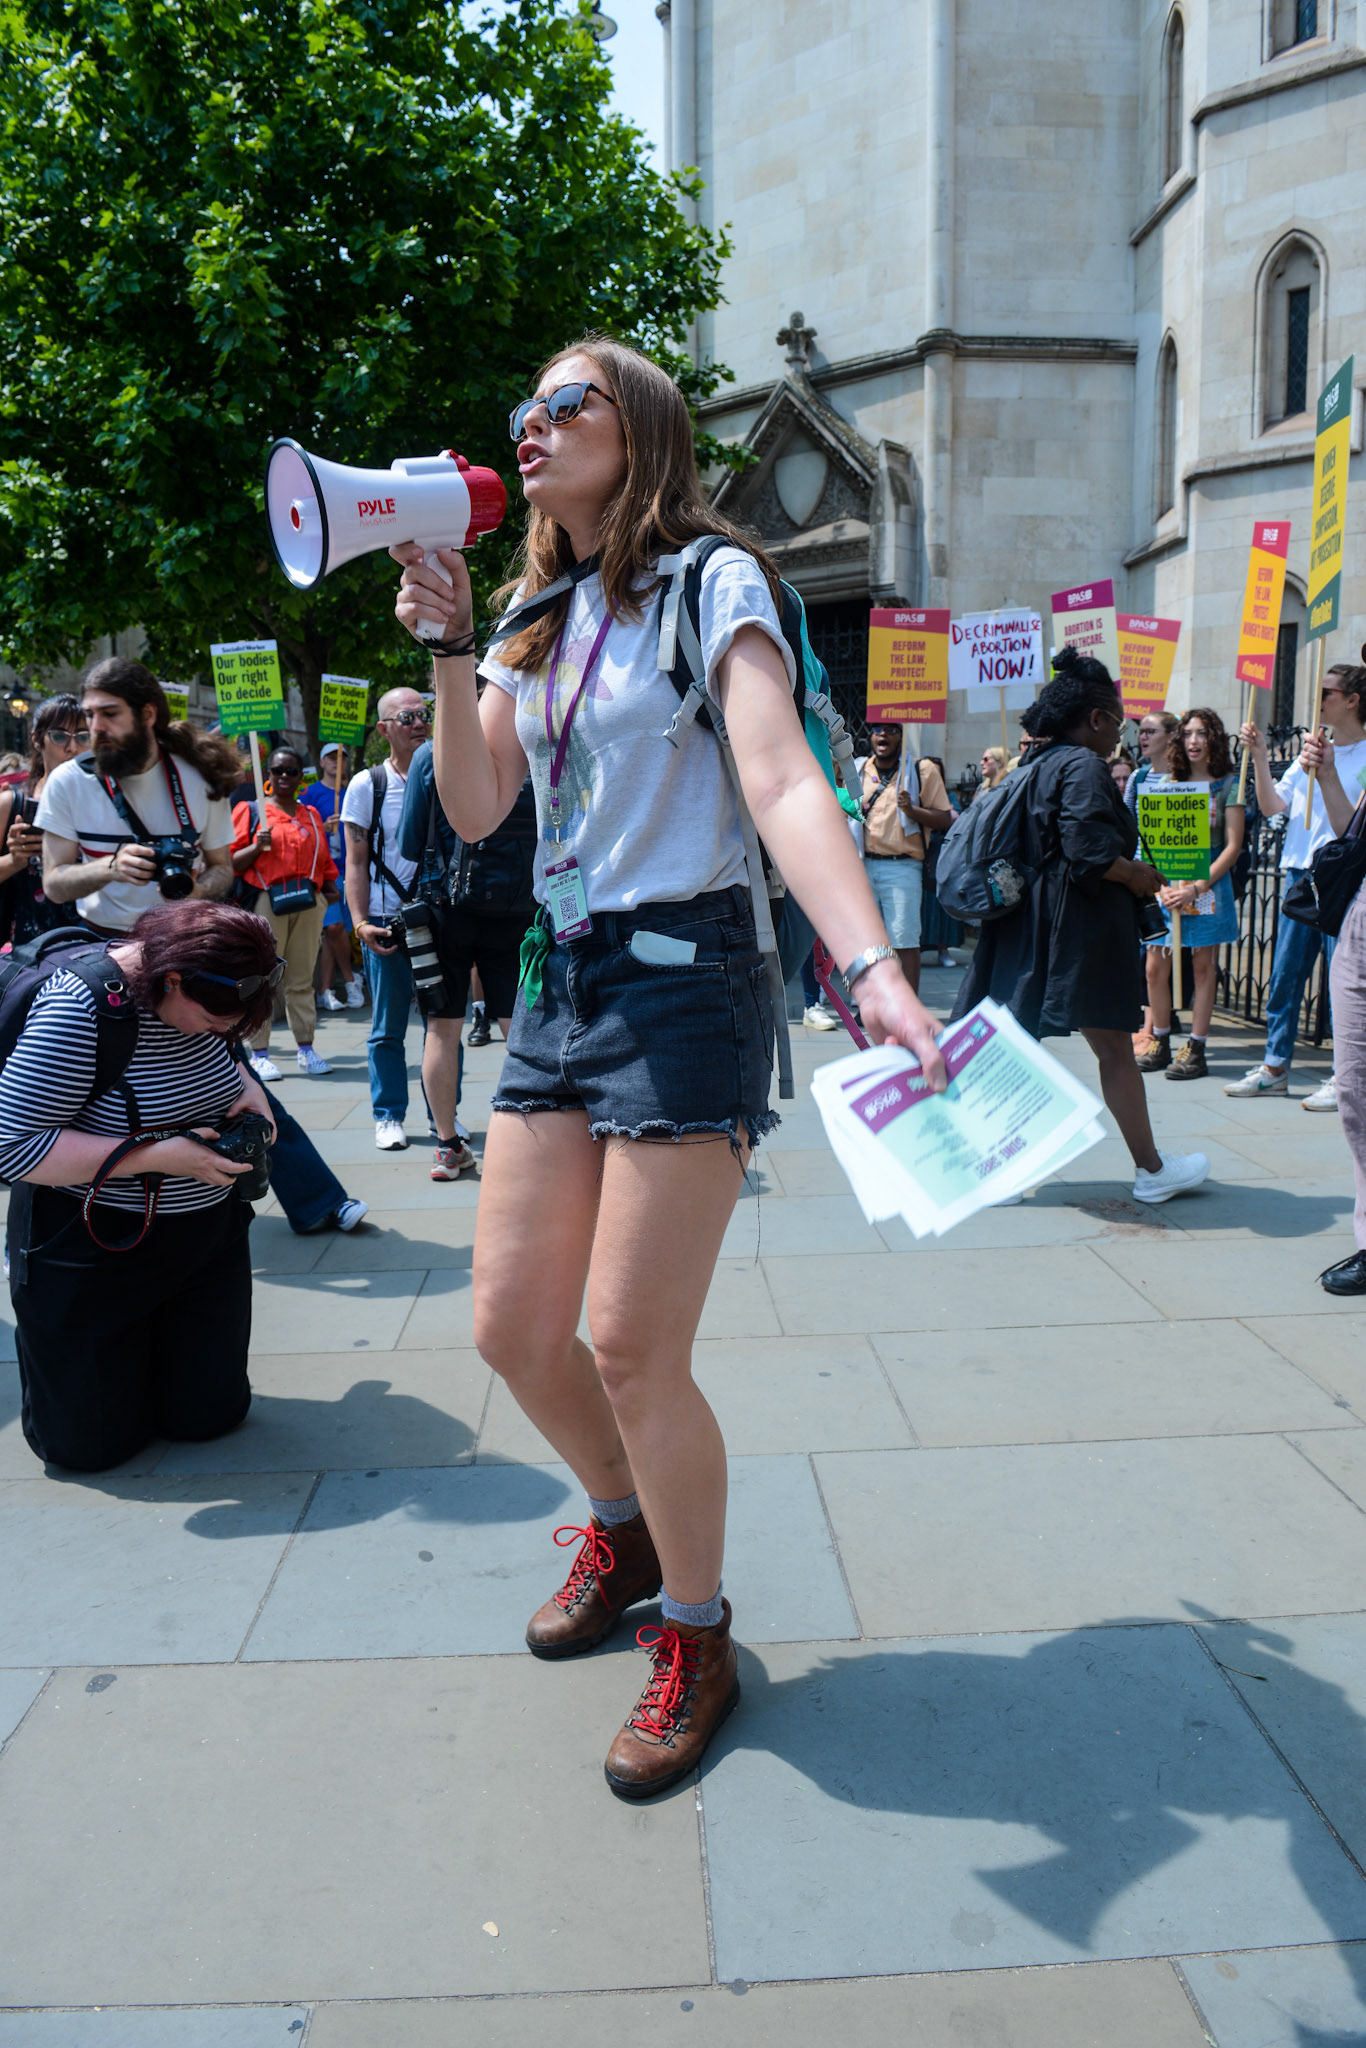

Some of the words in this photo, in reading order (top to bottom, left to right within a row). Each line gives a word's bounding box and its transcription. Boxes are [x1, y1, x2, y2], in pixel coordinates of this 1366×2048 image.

[357, 498, 396, 517] PYLE
[1067, 590, 1085, 605] BPAS
[894, 613, 916, 623] BPAS
[1128, 619, 1150, 630] BPAS
[952, 619, 1041, 645] DECRIMINALISE
[1064, 620, 1094, 637] ABORTION
[1096, 618, 1103, 629] IS
[892, 640, 926, 651] REFORM
[971, 635, 1032, 658] ABORTION
[1123, 642, 1155, 655] REFORM
[216, 655, 235, 670] Our
[239, 652, 275, 668] bodies
[890, 654, 905, 665] THE
[907, 654, 928, 665] LAW,
[1120, 654, 1133, 665] THE
[1134, 656, 1153, 668] LAW,
[890, 667, 926, 678] PROTECT
[979, 653, 1034, 683] NOW!
[217, 672, 237, 686] Our
[241, 669, 269, 688] right
[872, 680, 912, 691] WOMEN'S
[914, 680, 943, 691] RIGHTS
[1137, 680, 1165, 692] RIGHTS
[220, 689, 232, 702] to
[236, 685, 272, 700] decide
[324, 683, 337, 694] Our
[340, 686, 365, 699] bodies
[323, 695, 337, 707] Our
[340, 698, 359, 712] right
[322, 708, 331, 718] to
[333, 709, 359, 722] decide
[881, 707, 932, 719] #TimeToAct
[1149, 786, 1174, 794] Socialist
[1142, 796, 1162, 811] Our
[1166, 795, 1206, 811] bodies
[1142, 813, 1162, 828] Our
[1167, 813, 1197, 832] right
[1143, 831, 1155, 845] to
[1159, 831, 1198, 846] decide
